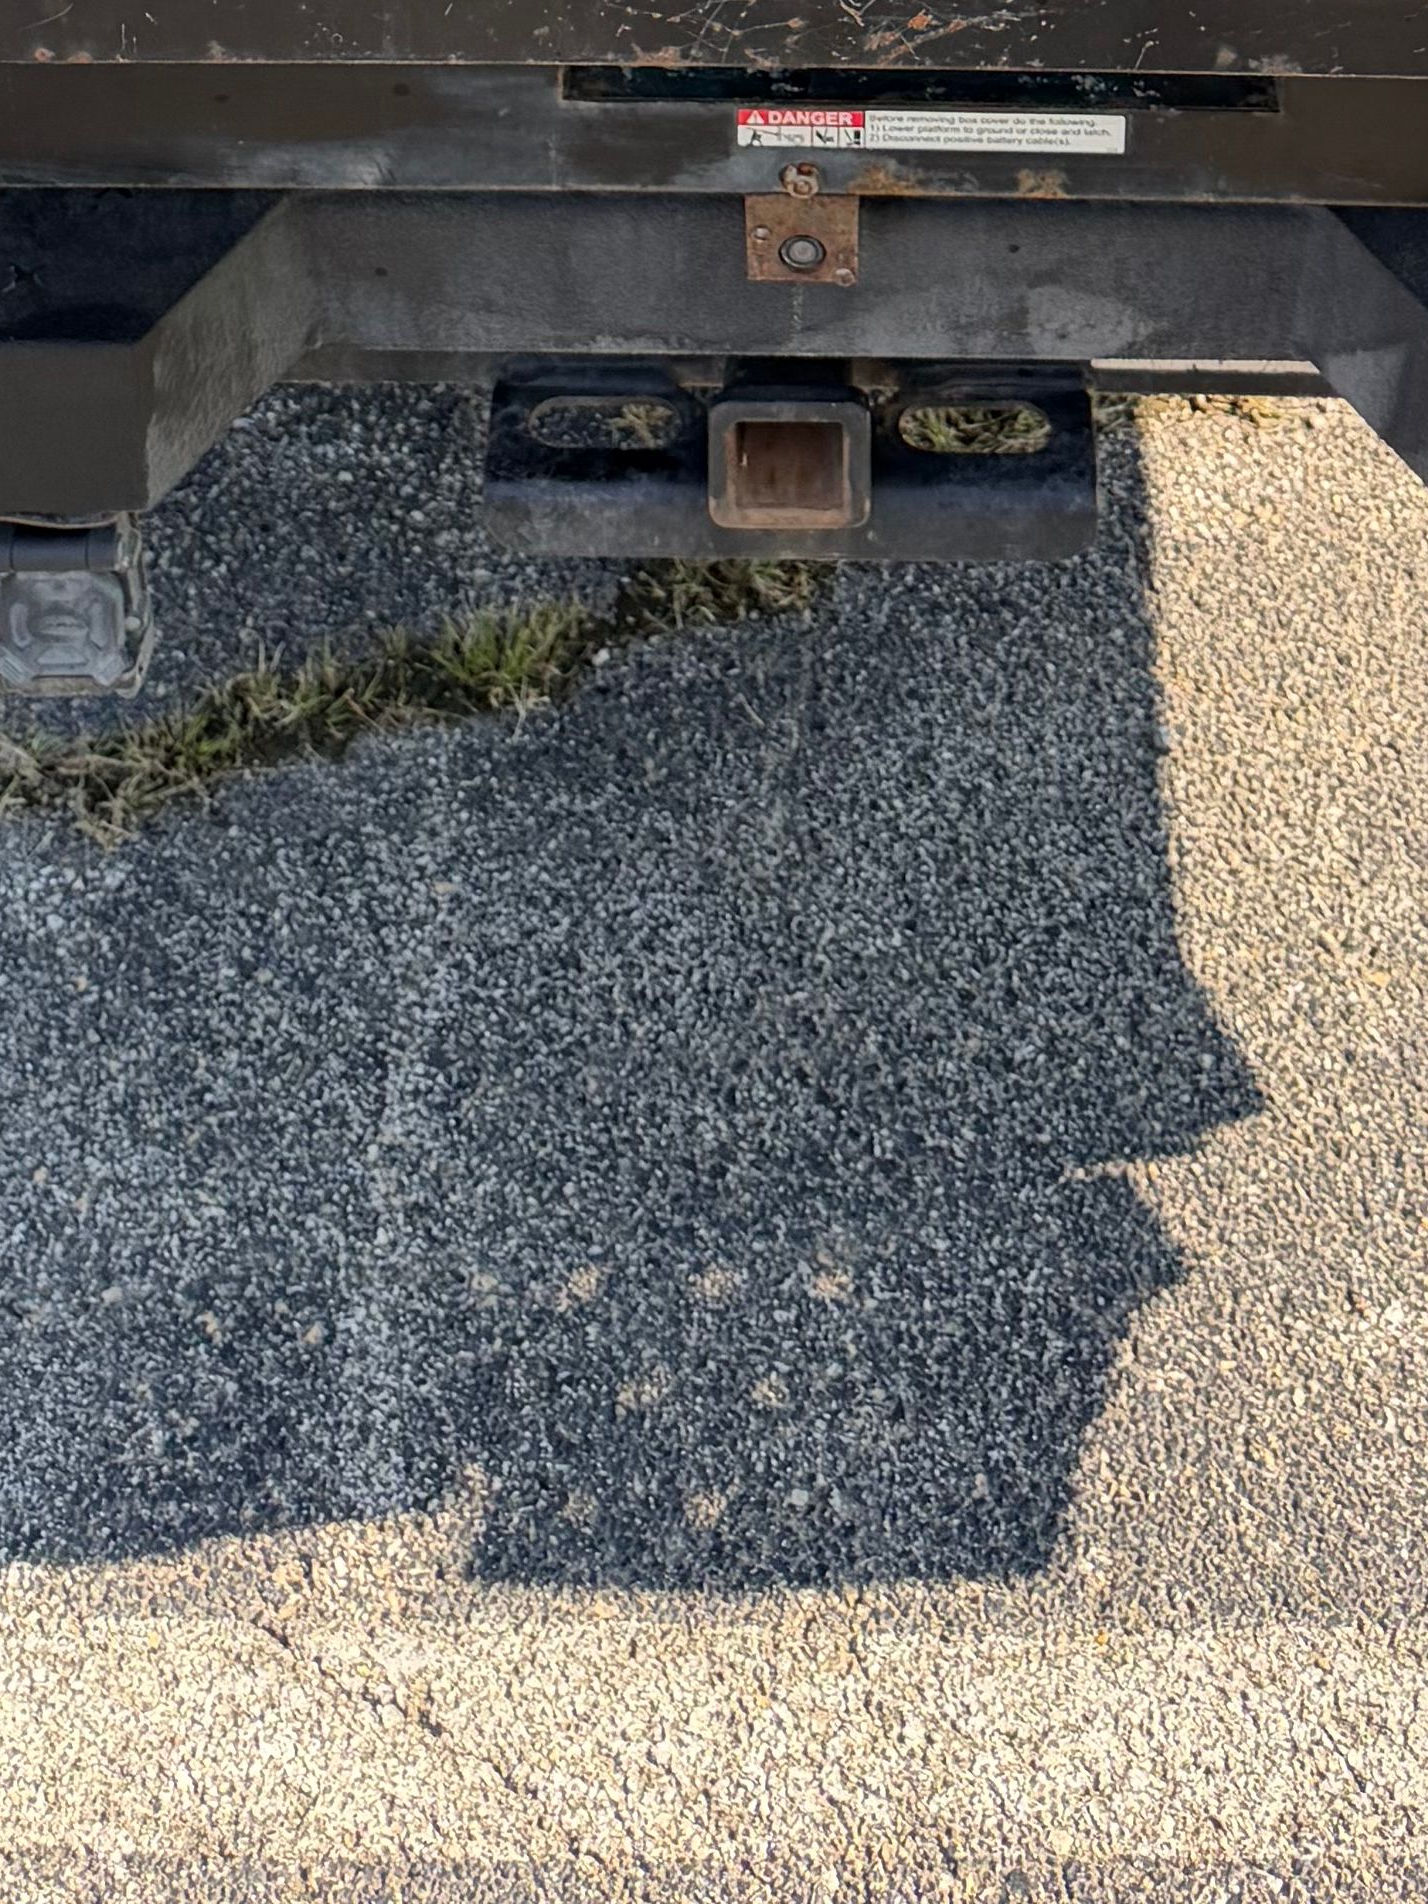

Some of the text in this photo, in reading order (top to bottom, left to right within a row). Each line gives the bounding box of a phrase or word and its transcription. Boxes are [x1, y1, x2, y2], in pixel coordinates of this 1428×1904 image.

[767, 111, 853, 125] DANGER
[907, 116, 956, 125] removing
[882, 134, 941, 142] Disconnect
